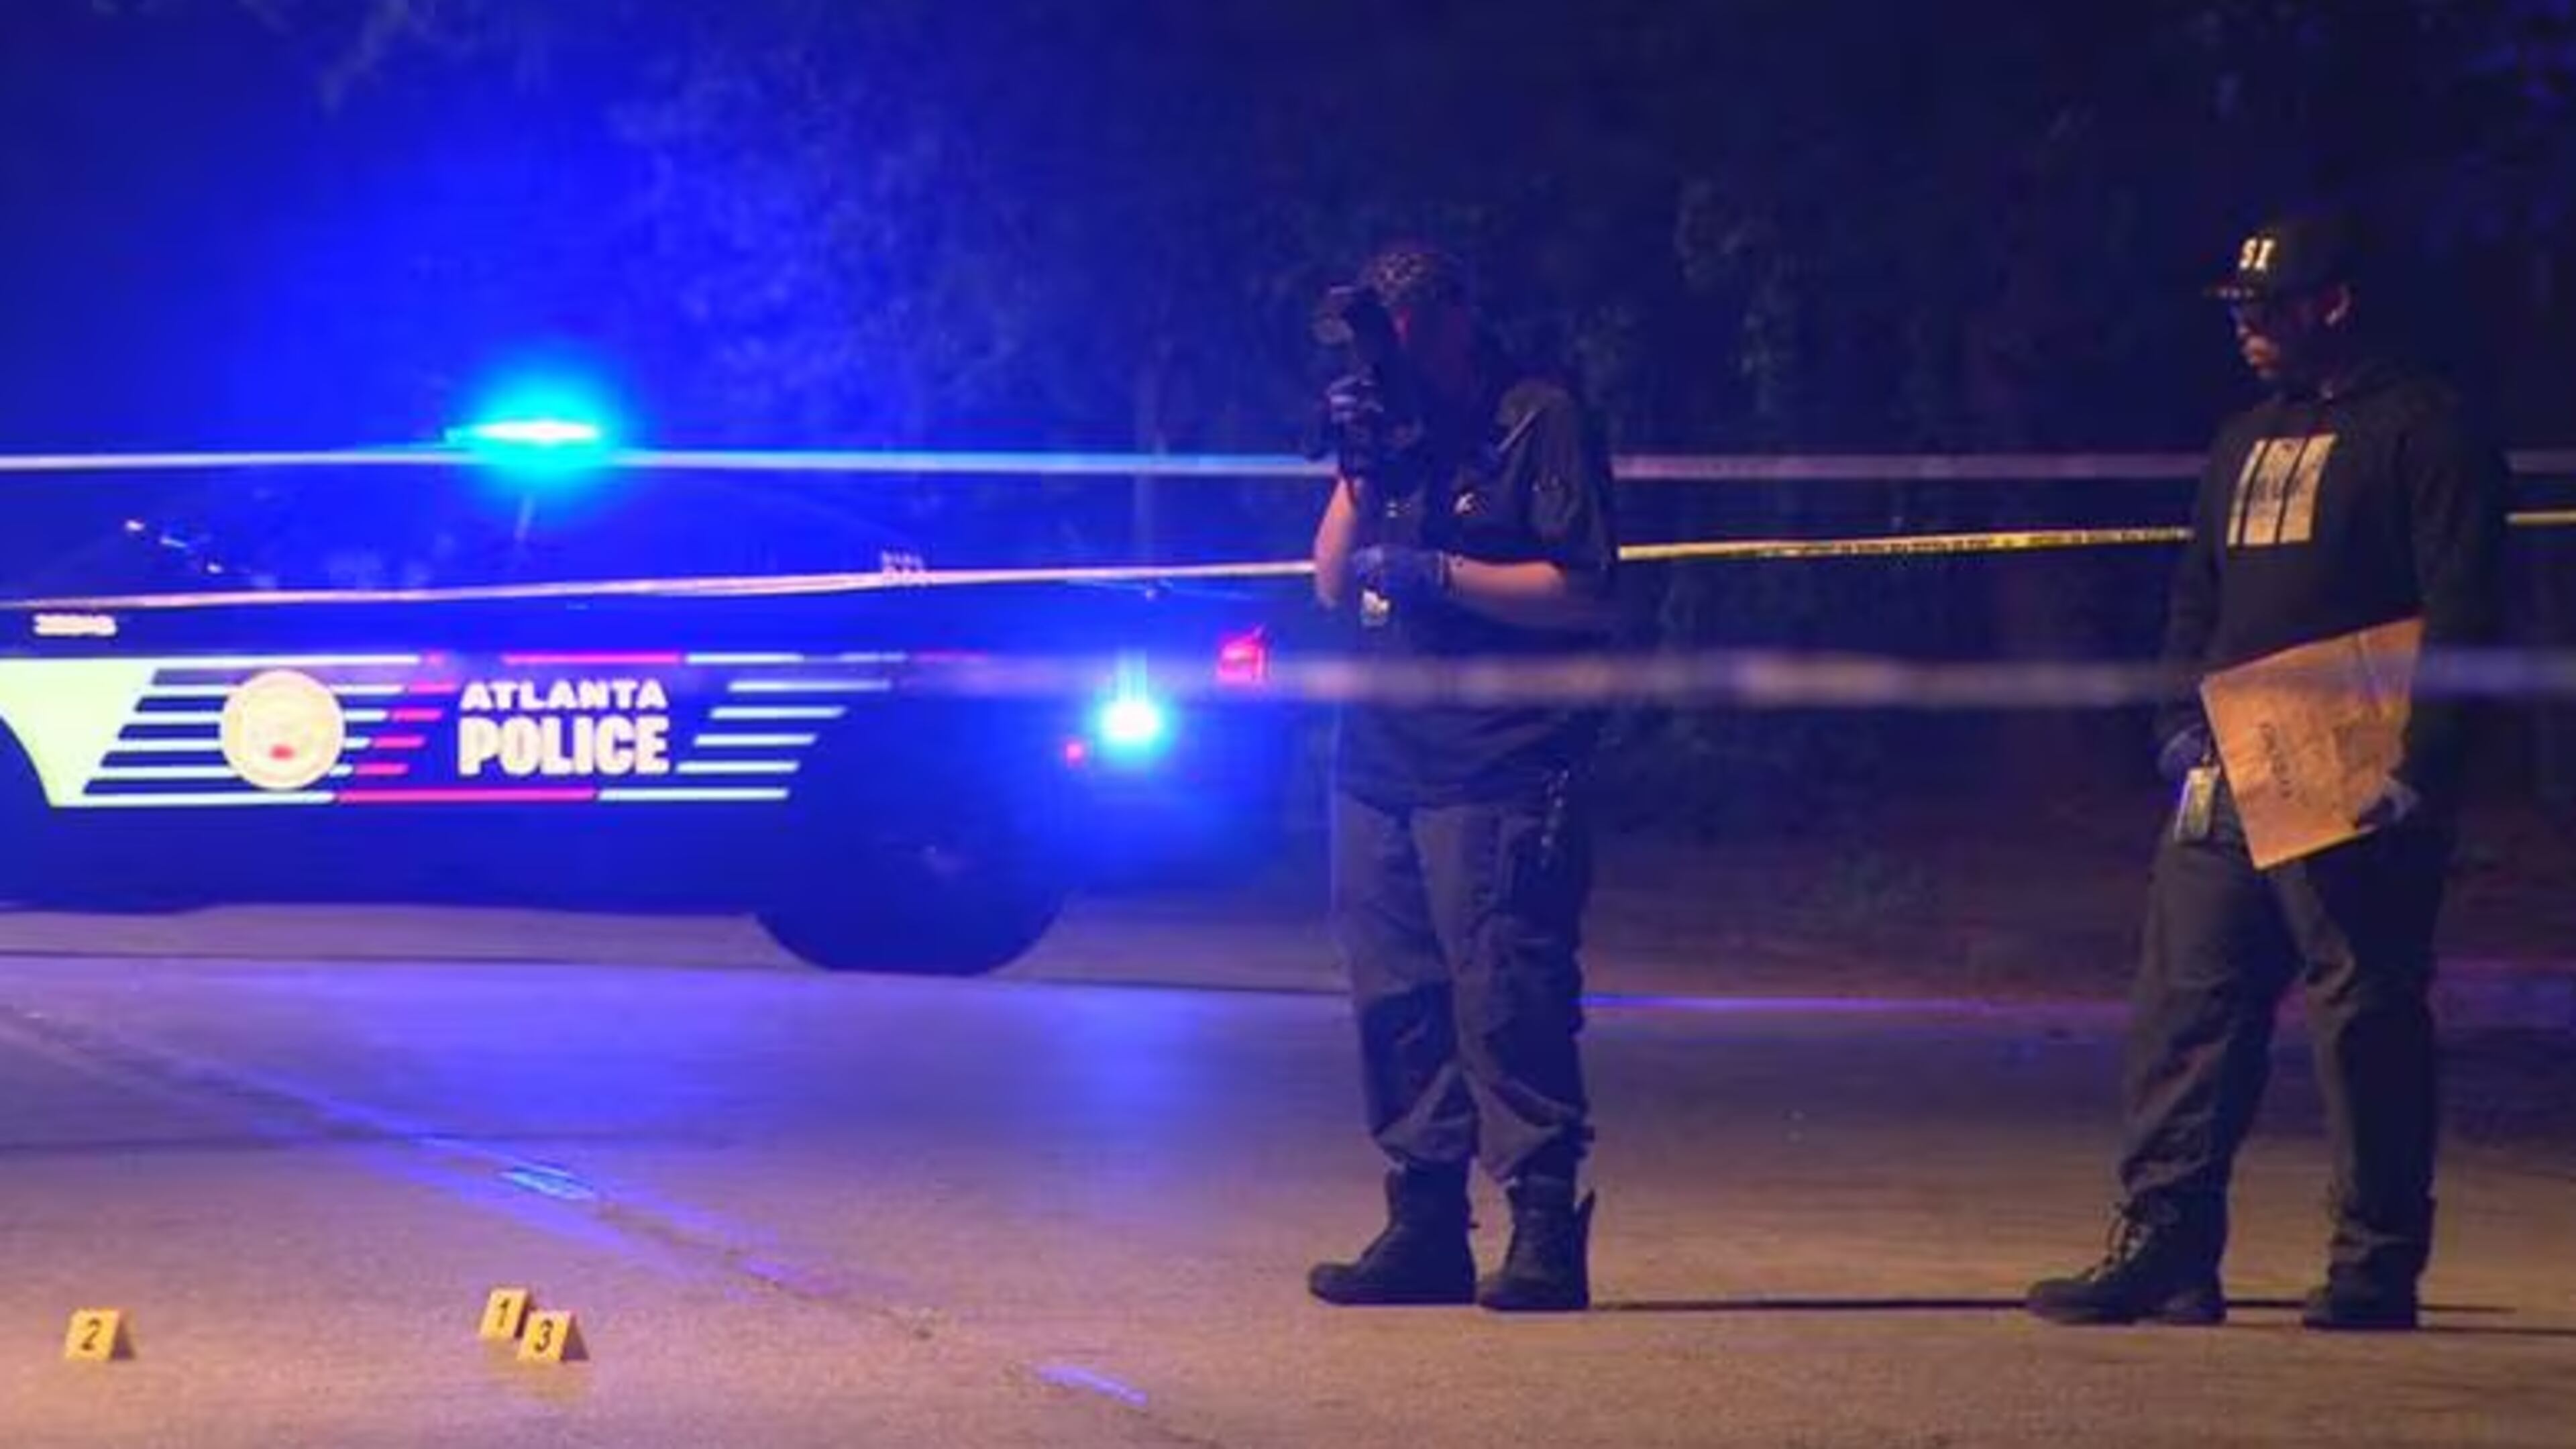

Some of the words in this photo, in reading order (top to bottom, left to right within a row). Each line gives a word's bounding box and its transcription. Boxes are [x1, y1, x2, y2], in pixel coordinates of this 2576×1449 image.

[461, 679, 667, 710] ATLANTA
[459, 715, 669, 775] POLICE
[497, 1297, 511, 1329] 1
[80, 1318, 101, 1351] 2
[534, 1319, 554, 1352] 3
